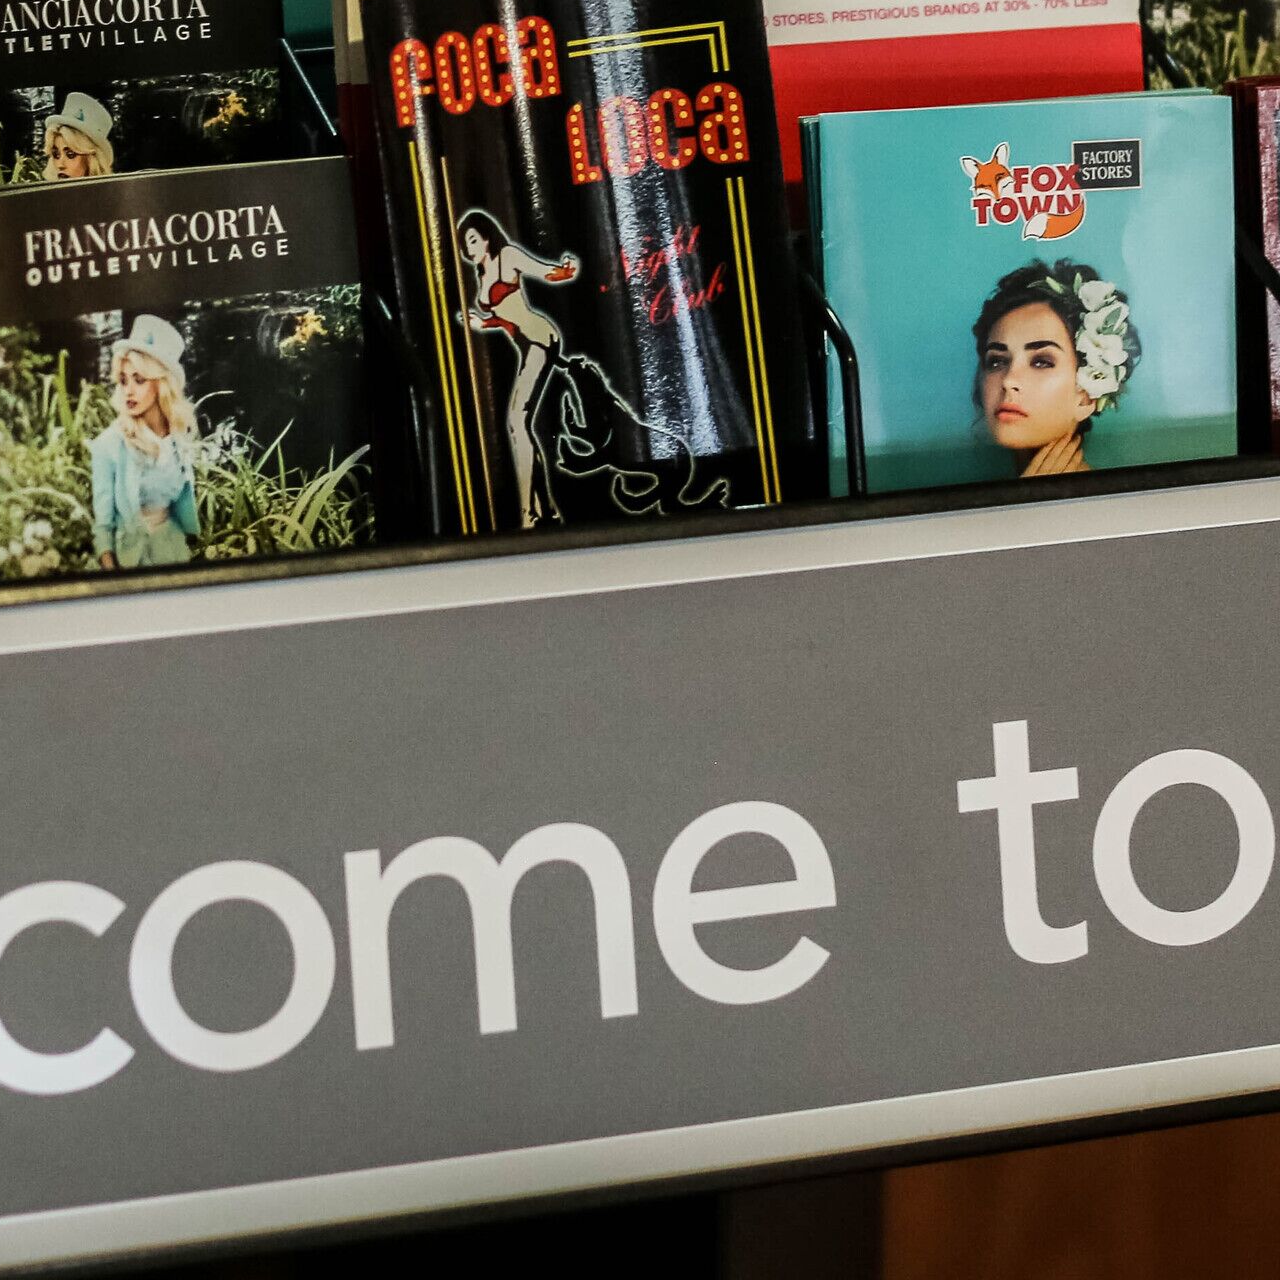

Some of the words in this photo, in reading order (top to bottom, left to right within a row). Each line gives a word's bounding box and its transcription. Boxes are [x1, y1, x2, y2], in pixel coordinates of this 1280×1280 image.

[772, 14, 827, 27] STORES.
[832, 7, 919, 22] PRESTIGIOUS
[924, 3, 980, 16] BRANDS
[984, 2, 998, 13] AT
[1004, 0, 1030, 11] 30%
[1081, 162, 1133, 181] STORES
[1082, 149, 1133, 167] FACTORY
[1014, 164, 1079, 194] FOX
[972, 192, 1082, 223] TOWN
[26, 204, 285, 265] FRANCIACORTA
[956, 718, 1275, 966] to
